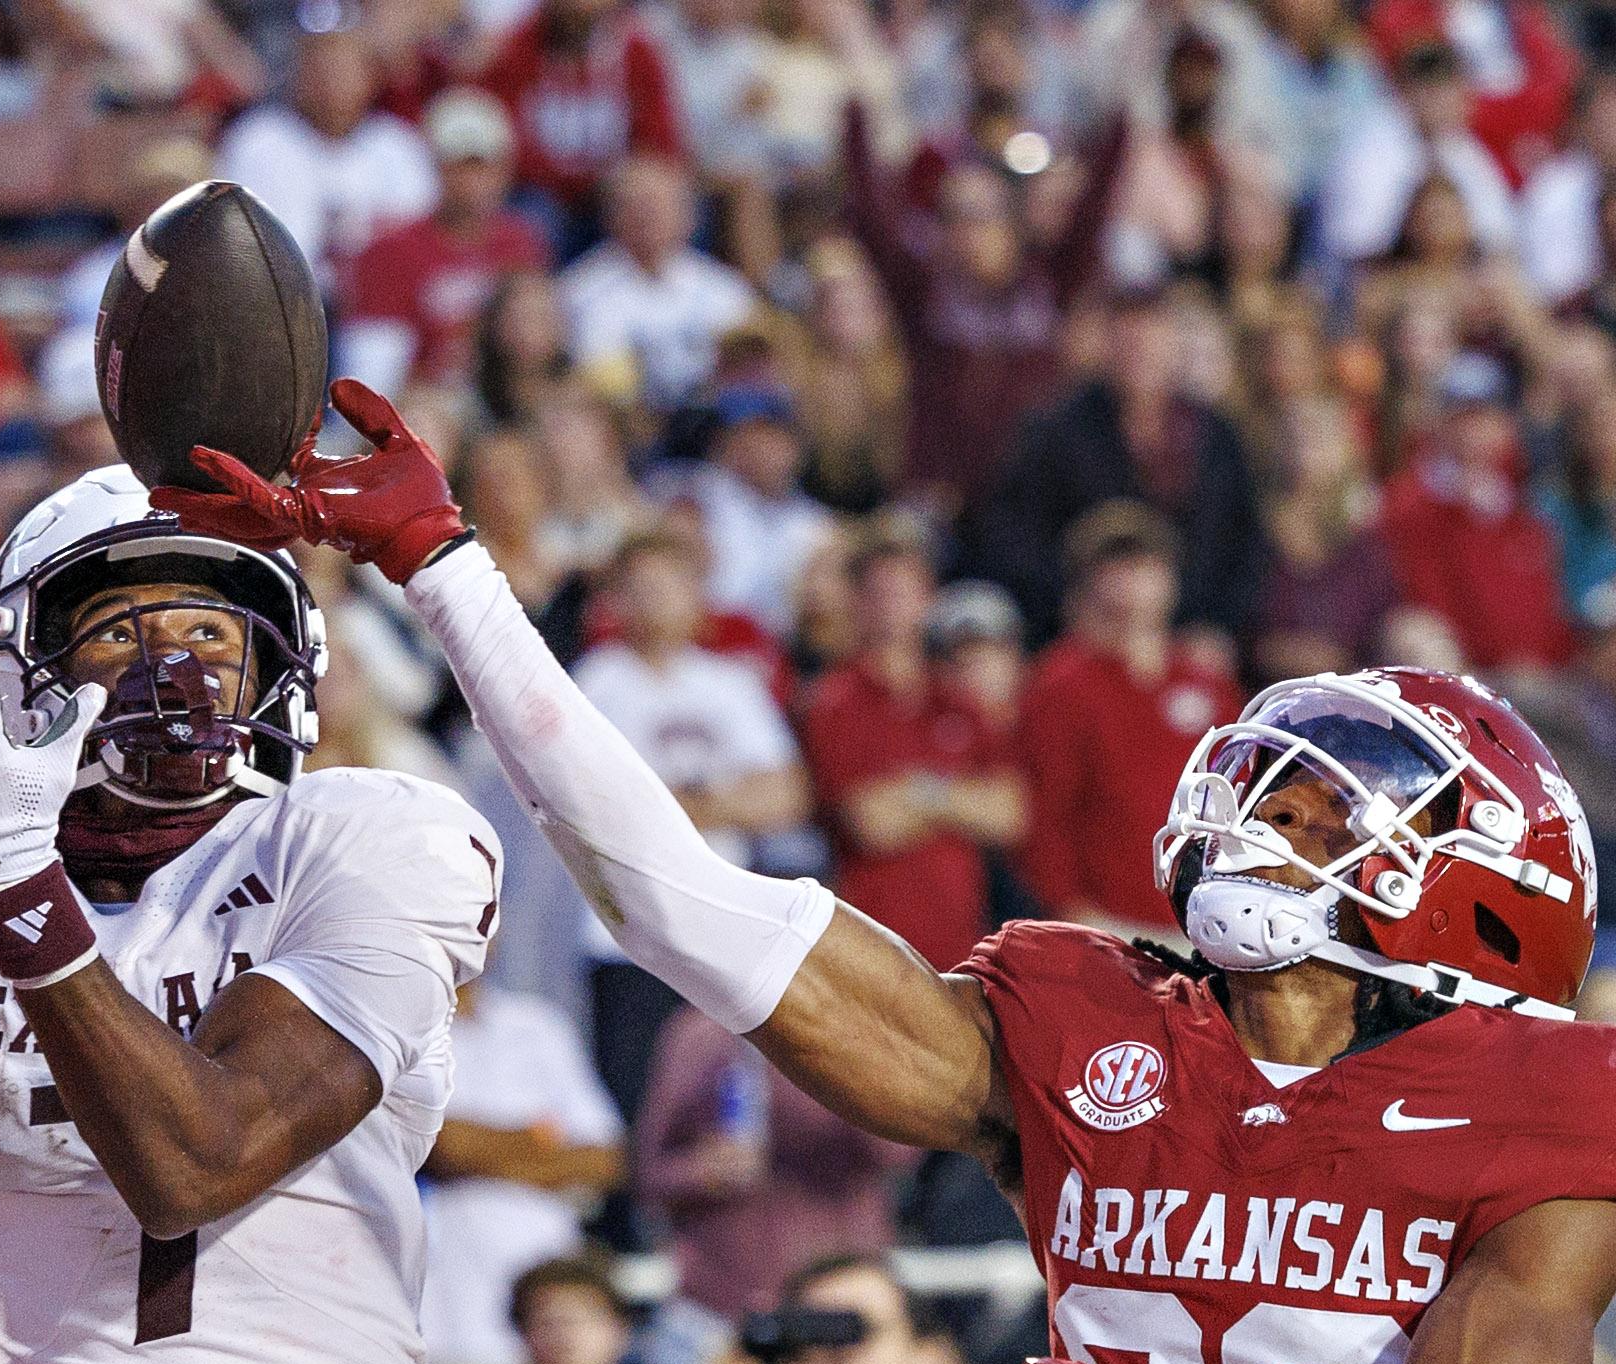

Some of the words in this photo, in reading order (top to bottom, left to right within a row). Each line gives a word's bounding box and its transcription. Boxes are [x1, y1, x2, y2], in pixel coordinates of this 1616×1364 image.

[1092, 1045, 1159, 1104] SEC
[1078, 1101, 1147, 1127] GRADUATE
[1050, 1167, 1457, 1304] ARKANSAS
